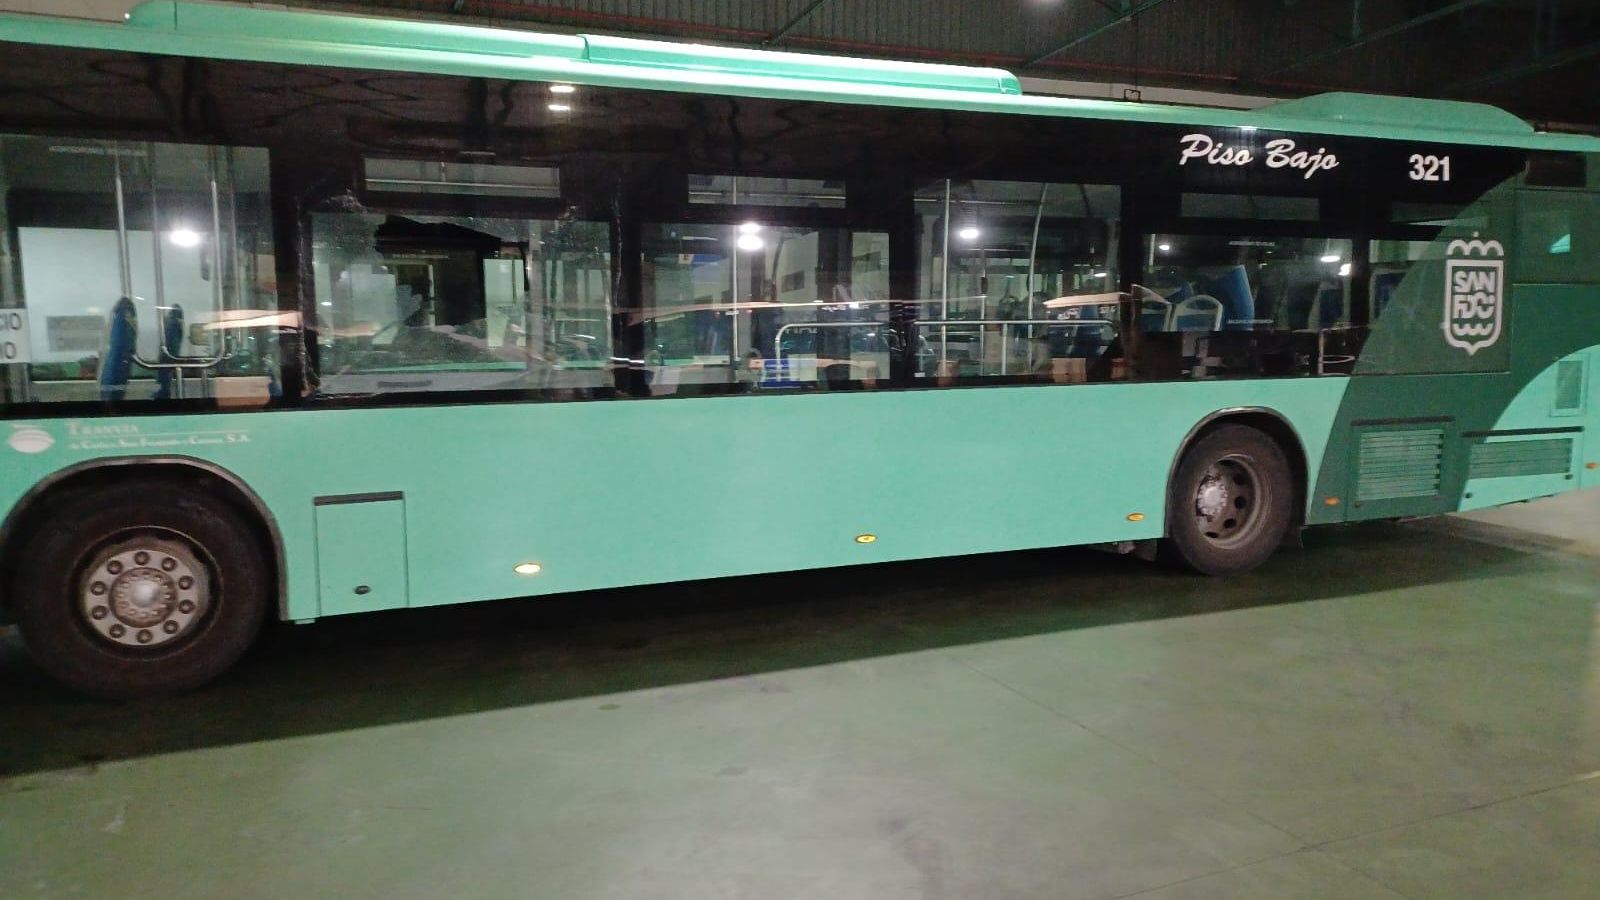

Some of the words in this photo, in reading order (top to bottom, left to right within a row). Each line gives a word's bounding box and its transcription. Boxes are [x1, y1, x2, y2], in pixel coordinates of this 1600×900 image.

[1179, 133, 1254, 166] Piso
[1265, 138, 1339, 179] Bajo
[1409, 153, 1450, 181] 321
[1453, 270, 1496, 293] SAN
